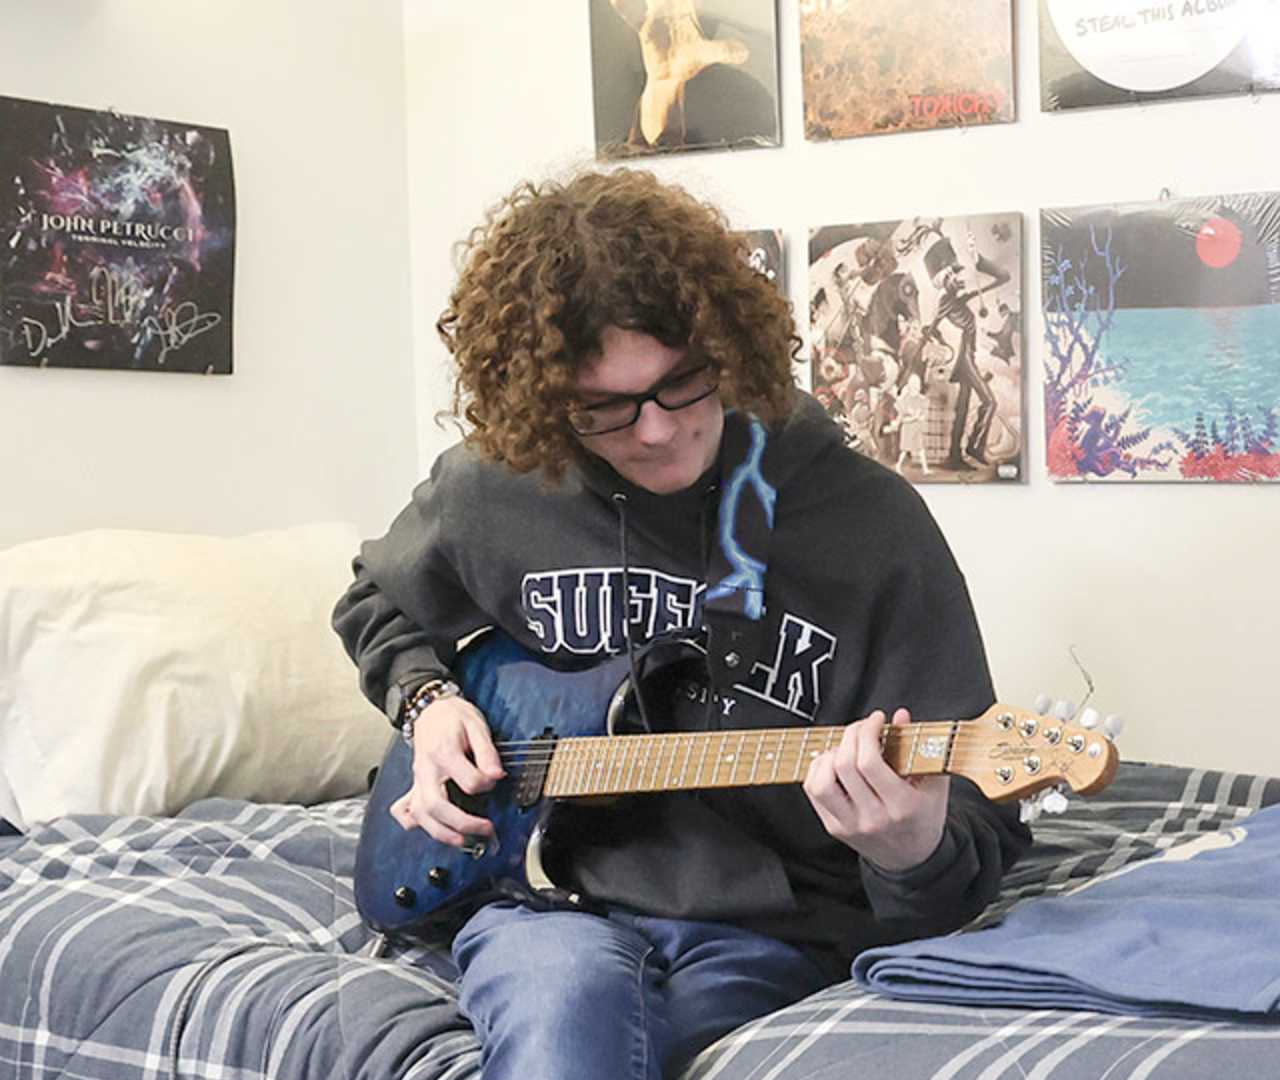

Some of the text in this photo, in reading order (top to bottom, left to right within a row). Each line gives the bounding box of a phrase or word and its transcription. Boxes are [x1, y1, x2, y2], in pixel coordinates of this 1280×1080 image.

[1075, 15, 1136, 37] STEAL
[1137, 5, 1174, 24] THIS
[41, 213, 193, 242] JOHN PETRUCCI
